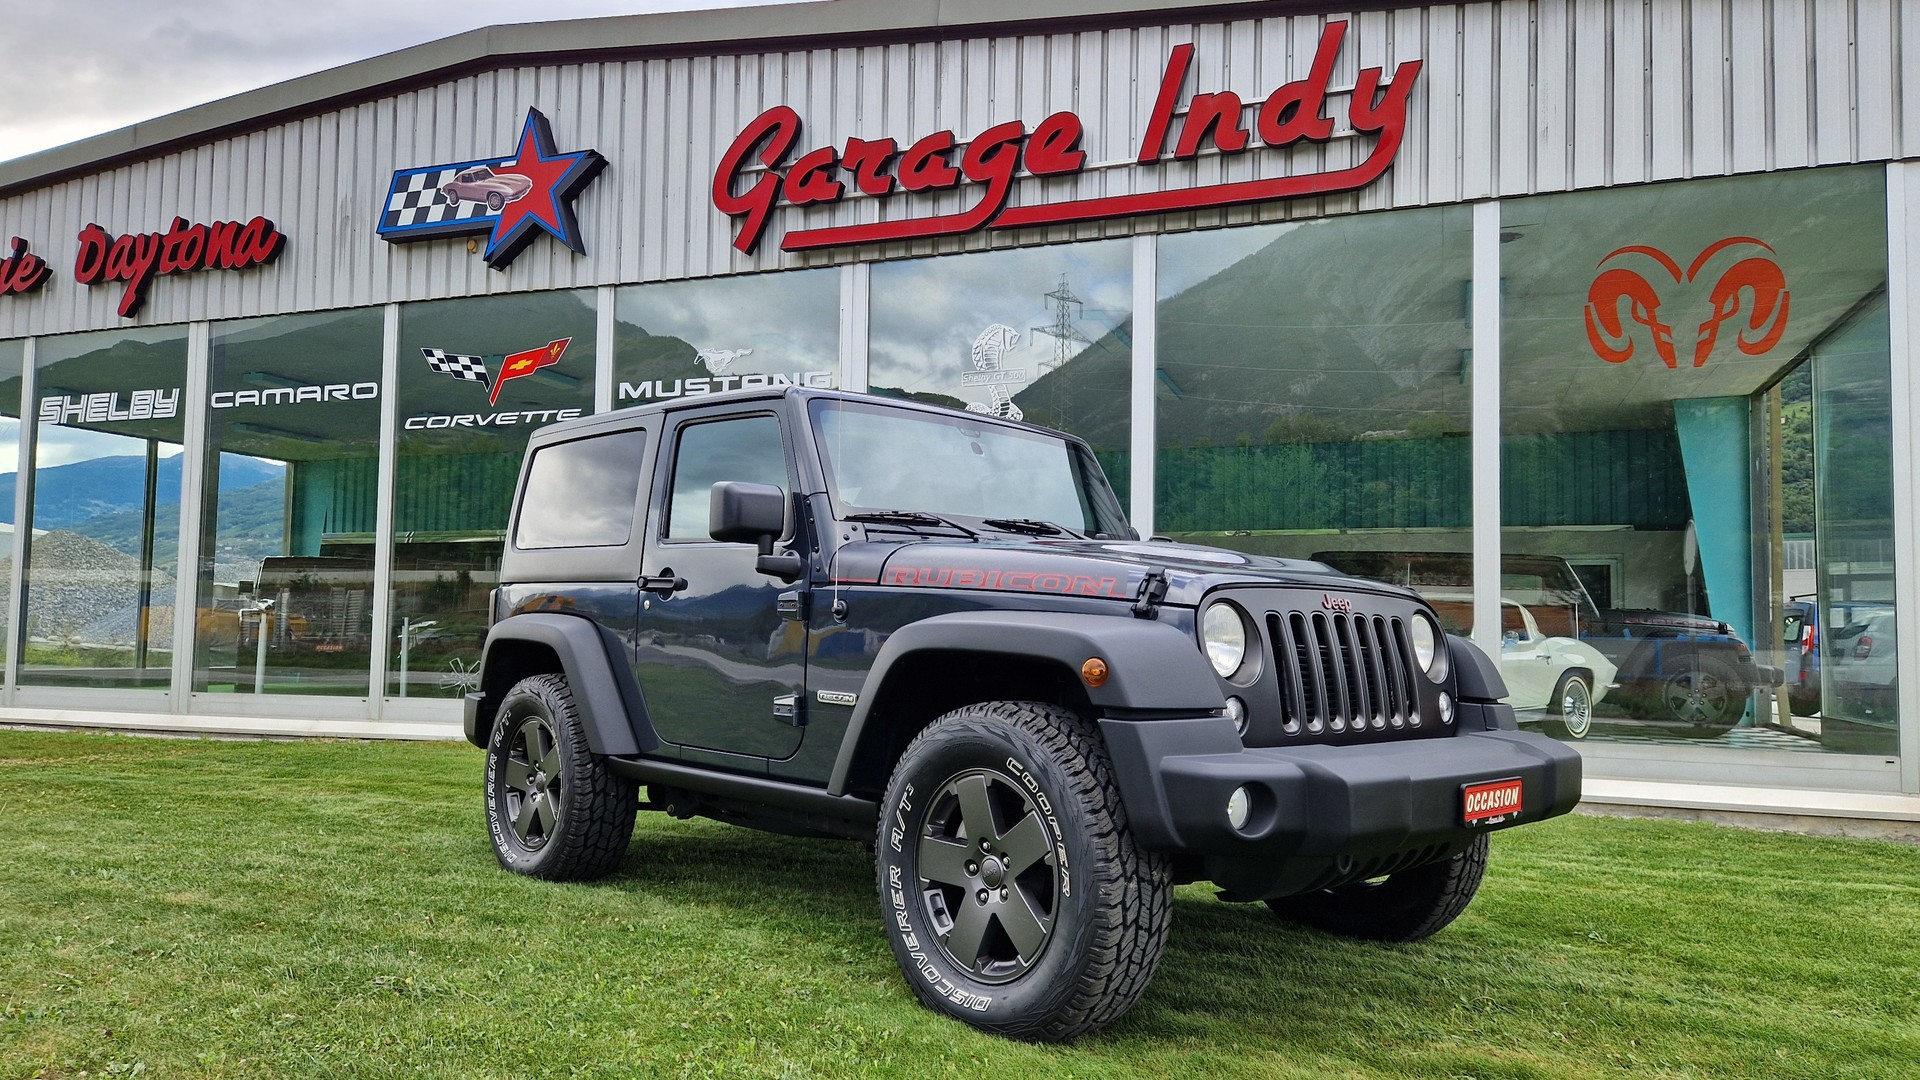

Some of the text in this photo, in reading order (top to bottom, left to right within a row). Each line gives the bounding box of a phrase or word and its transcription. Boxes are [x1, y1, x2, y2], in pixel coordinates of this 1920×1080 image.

[713, 20, 1424, 255] Garage Indy
[75, 215, 286, 318] Daytona
[619, 371, 833, 399] MUSTANG
[963, 370, 1024, 382] Shelby GT 500
[39, 388, 180, 424] SHELBY
[211, 382, 378, 408] CAMARO
[404, 408, 582, 430] CORVETTE
[884, 566, 1128, 597] RUBICON
[1322, 593, 1352, 614] Jeep
[819, 693, 854, 703] RECON
[488, 753, 518, 864] DISCOVERER
[1467, 787, 1519, 813] OCCASION
[1006, 757, 1071, 898] COOPER
[889, 865, 993, 1012] DISCOVERER
